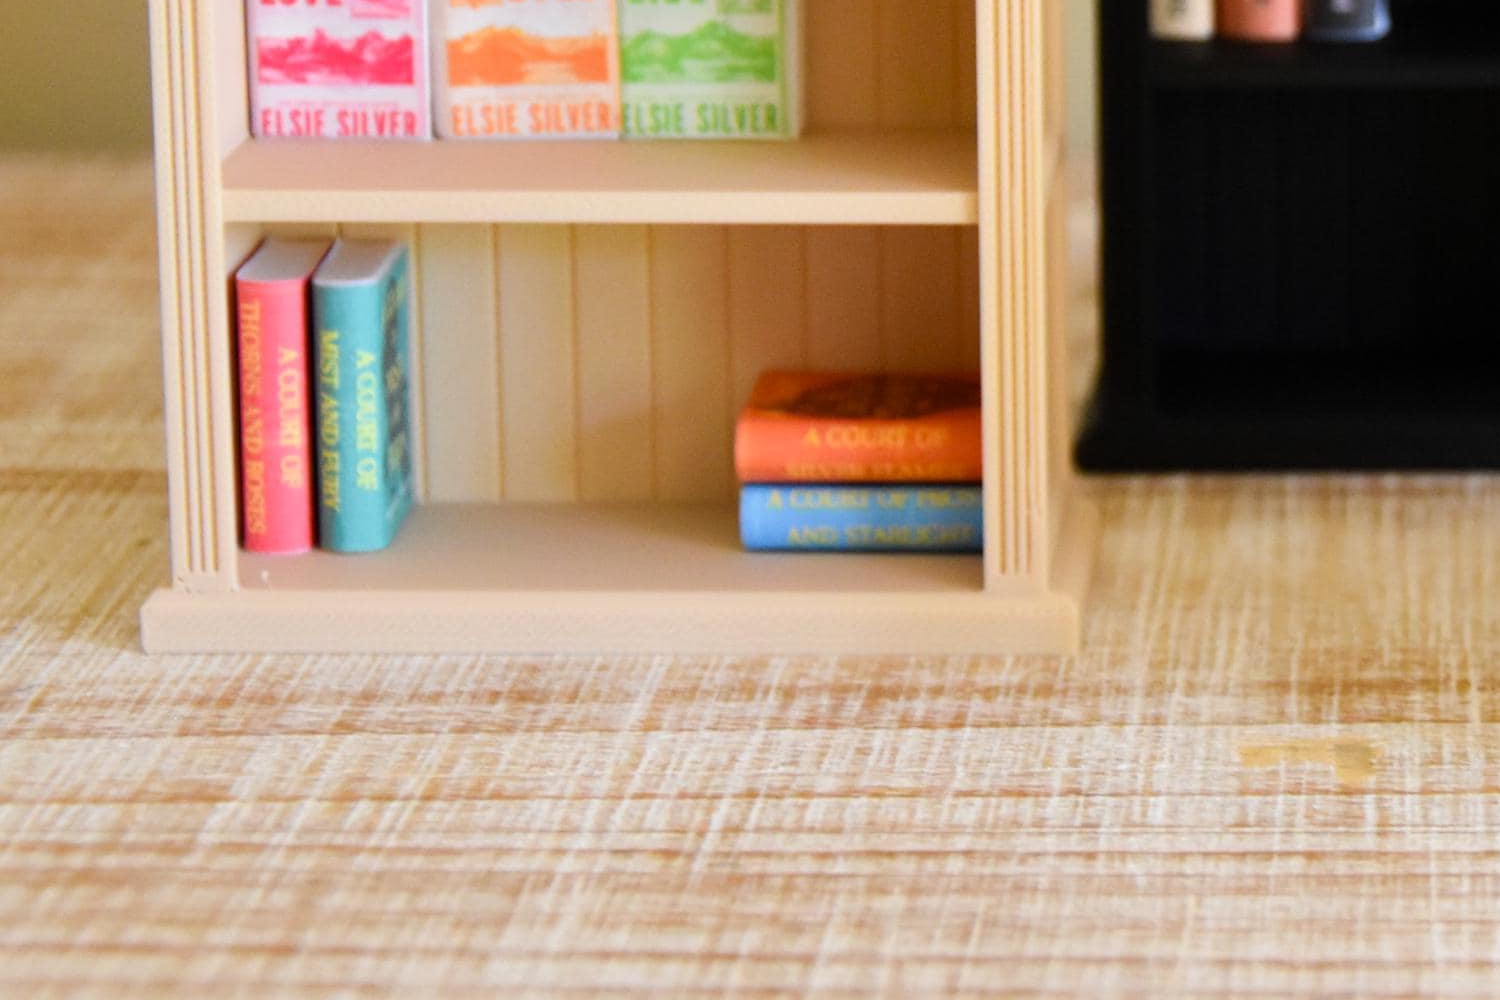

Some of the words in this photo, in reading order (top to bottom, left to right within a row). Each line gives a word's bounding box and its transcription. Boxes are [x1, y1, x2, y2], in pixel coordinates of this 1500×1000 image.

[261, 107, 325, 137] ELSIE
[336, 107, 418, 137] SILVER
[452, 103, 518, 136] ELSIE
[528, 101, 612, 134] SILVER
[624, 102, 685, 136] ELSIE
[697, 101, 778, 136] SILVER
[241, 300, 261, 397] THORNS
[278, 347, 300, 365] A
[319, 329, 339, 391] MIST
[355, 350, 376, 368] A
[279, 368, 302, 448] COURT
[320, 393, 340, 447] AND
[356, 371, 377, 452] COURT
[244, 405, 263, 455] AND
[803, 425, 820, 447] A
[826, 423, 905, 449] COURT
[281, 455, 304, 489] OF
[321, 449, 341, 513] FURY
[357, 458, 378, 491] OF
[246, 460, 267, 535] ROSES
